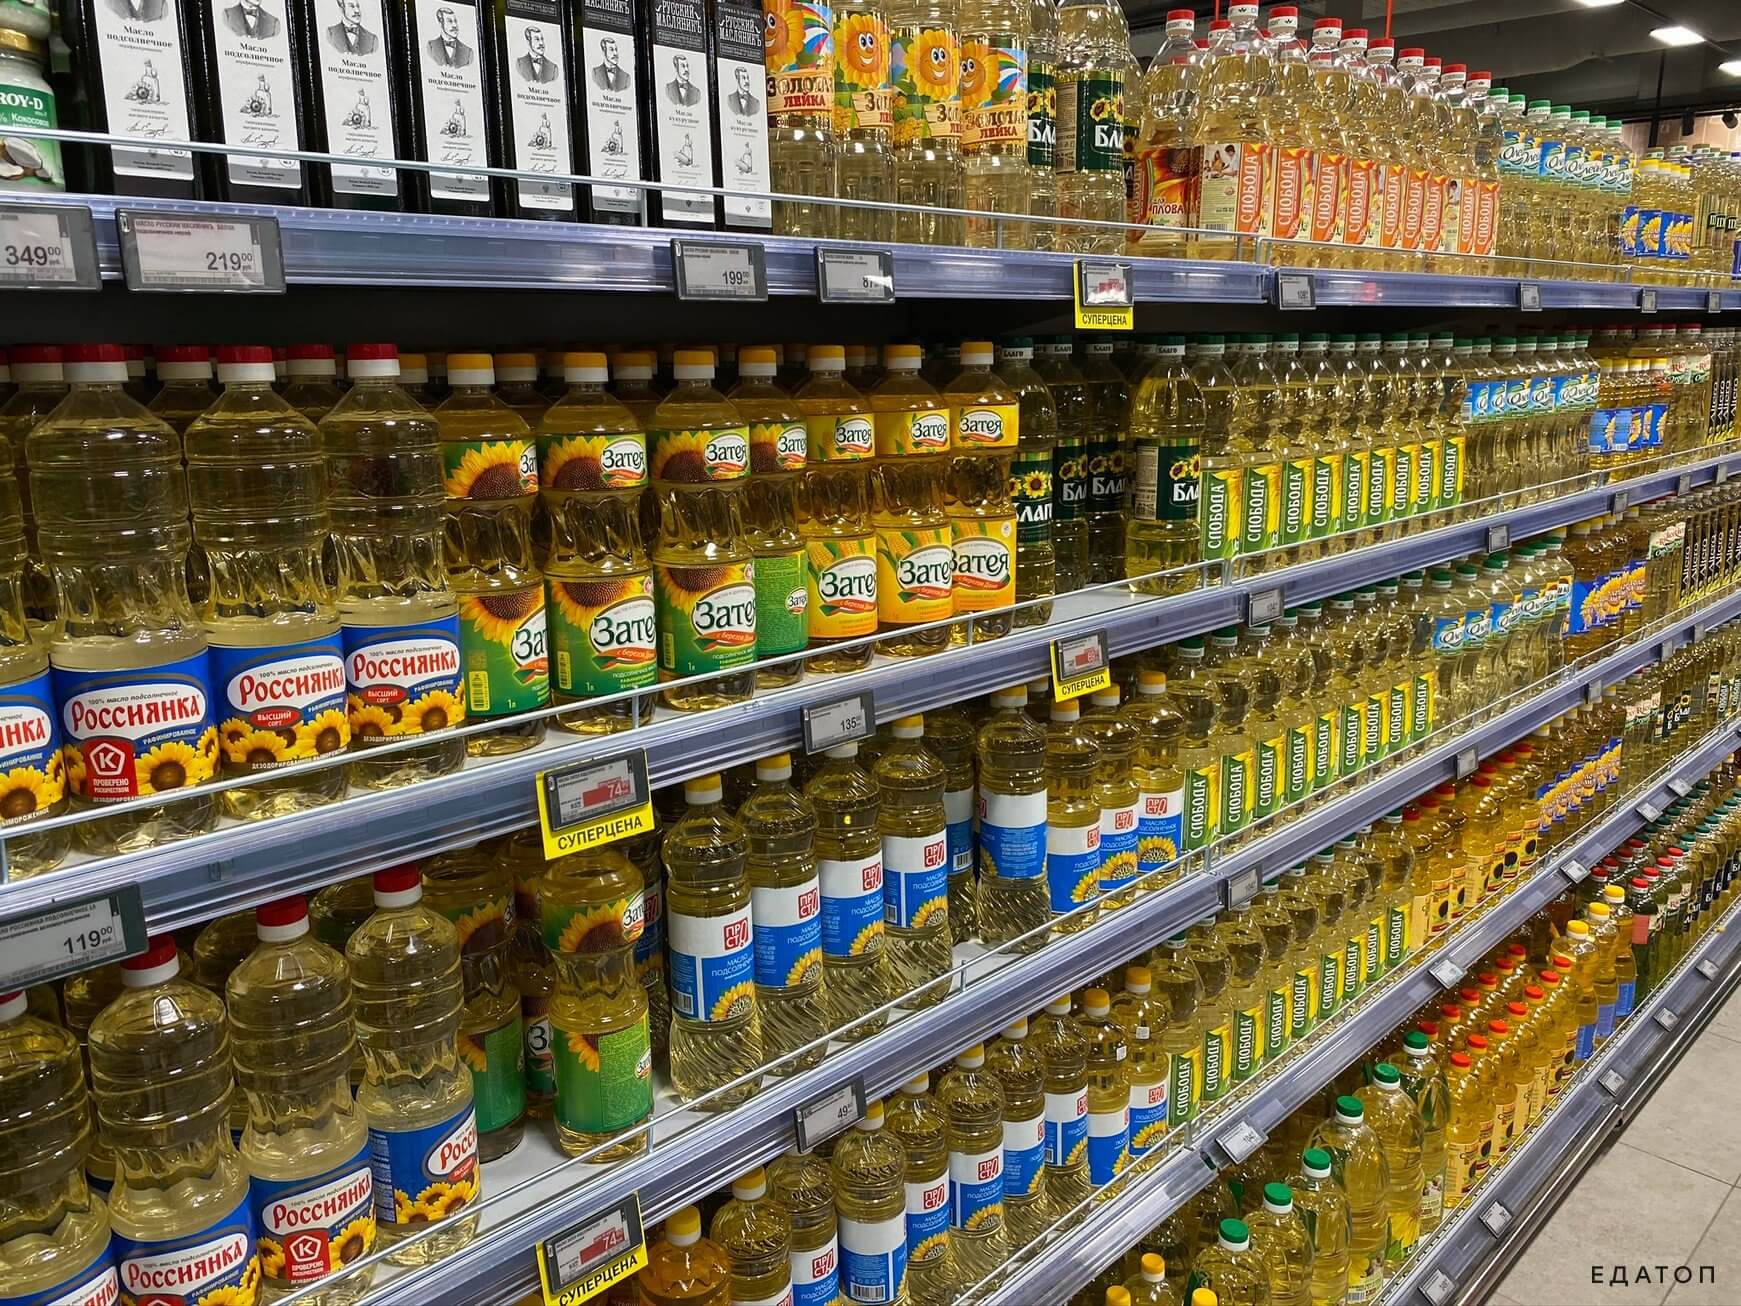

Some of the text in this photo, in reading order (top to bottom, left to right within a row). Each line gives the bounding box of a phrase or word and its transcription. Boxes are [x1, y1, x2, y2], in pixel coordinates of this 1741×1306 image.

[123, 25, 155, 38] Масло
[1240, 154, 1258, 223] СЛОБОДА
[1278, 159, 1296, 226] СЛОБОДА
[1316, 165, 1335, 229] СЛОБОДА
[1349, 171, 1366, 233] СЛОБОДА
[1384, 175, 1400, 236] СЛОБОДА
[1405, 180, 1422, 239] СЛОБОДА
[1424, 186, 1441, 241] СЛОБОДА
[1082, 313, 1127, 326] СУПЕРЦЕНА
[960, 416, 1003, 435] Затея
[1314, 467, 1329, 527] СЛОБОДА
[1346, 463, 1360, 522] СЛОБОДА
[1370, 459, 1384, 516] СЛОБОДА
[1394, 455, 1408, 510] СЛОБОДА
[1417, 451, 1431, 505] СЛОБОДА
[1443, 446, 1456, 499] СЛОБОДА
[1207, 483, 1225, 549] СЛОБОДА
[1247, 478, 1265, 542] СЛОБОДА
[1286, 472, 1302, 534] СЛОБОДА
[821, 572, 876, 598] Зате
[898, 560, 951, 587] Зате
[593, 615, 656, 647] Зате
[695, 600, 756, 630] Зате
[368, 688, 398, 698] ВЫСШИЙ
[1061, 673, 1105, 696] СУПЕРЦЕНА
[1415, 682, 1427, 732] СЛОБОДА
[71, 694, 200, 732] РОССИЯНКА
[257, 711, 292, 721] ВЫСШИЙ
[1367, 702, 1380, 754] СЛОБОДА
[1390, 692, 1403, 742] СЛОБОДА
[1291, 736, 1305, 792] СЛОБОДА
[1316, 723, 1328, 777] СЛОБОДА
[1346, 713, 1359, 767] СЛОБОДА
[93, 778, 129, 787] ПРОВЕРЕНО
[1229, 763, 1242, 823] СЛОБОДА
[1259, 749, 1274, 807] СЛОБОДА
[557, 815, 643, 850] СУПЕРЦЕНА
[1191, 778, 1206, 839] СЛОБОДА
[63, 930, 101, 954] 119
[1367, 926, 1378, 974] СЛОБОДА
[1389, 911, 1401, 959] СЛОБОДА
[1322, 960, 1335, 1010] СЛОБОДА
[1345, 943, 1358, 993] СЛОБОДА
[1270, 997, 1283, 1049] СЛОБОДА
[1293, 978, 1306, 1030] СЛОБОДА
[1206, 1038, 1220, 1091] СЛОБОДА
[1238, 1017, 1252, 1071] СЛОБОДА
[1177, 1063, 1190, 1116] СЛОБОДА
[128, 1237, 243, 1290] РОССИЯНКА
[291, 1260, 325, 1273] ПРОВЕРЕНО
[559, 1254, 638, 1306] СУПЕРЦЕНА
